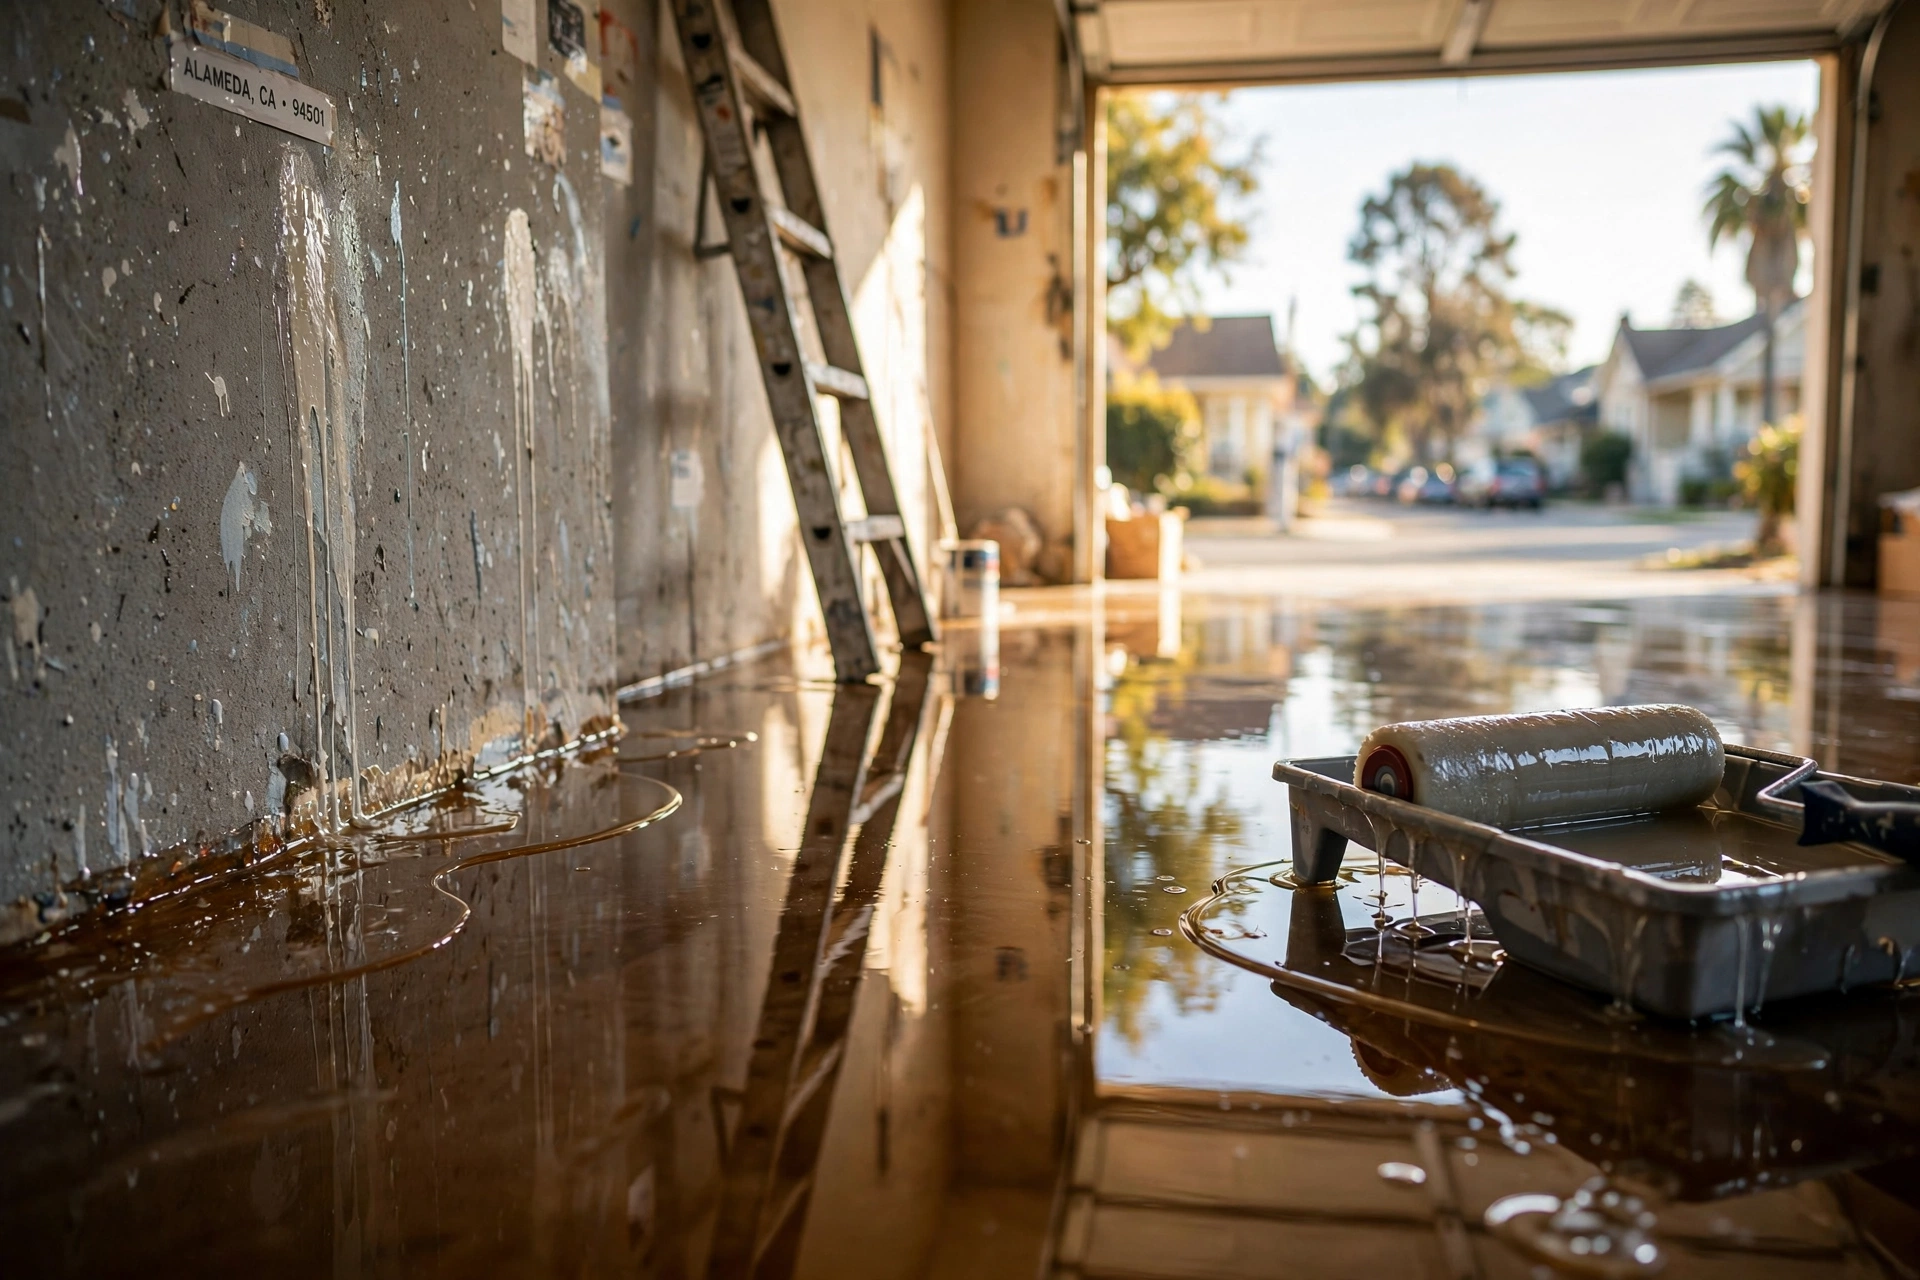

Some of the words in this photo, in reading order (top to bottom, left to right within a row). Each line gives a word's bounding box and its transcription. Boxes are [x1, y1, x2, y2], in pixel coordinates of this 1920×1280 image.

[184, 57, 254, 105] ALAMEDA,
[259, 86, 276, 109] CA
[293, 99, 325, 127] 94501
